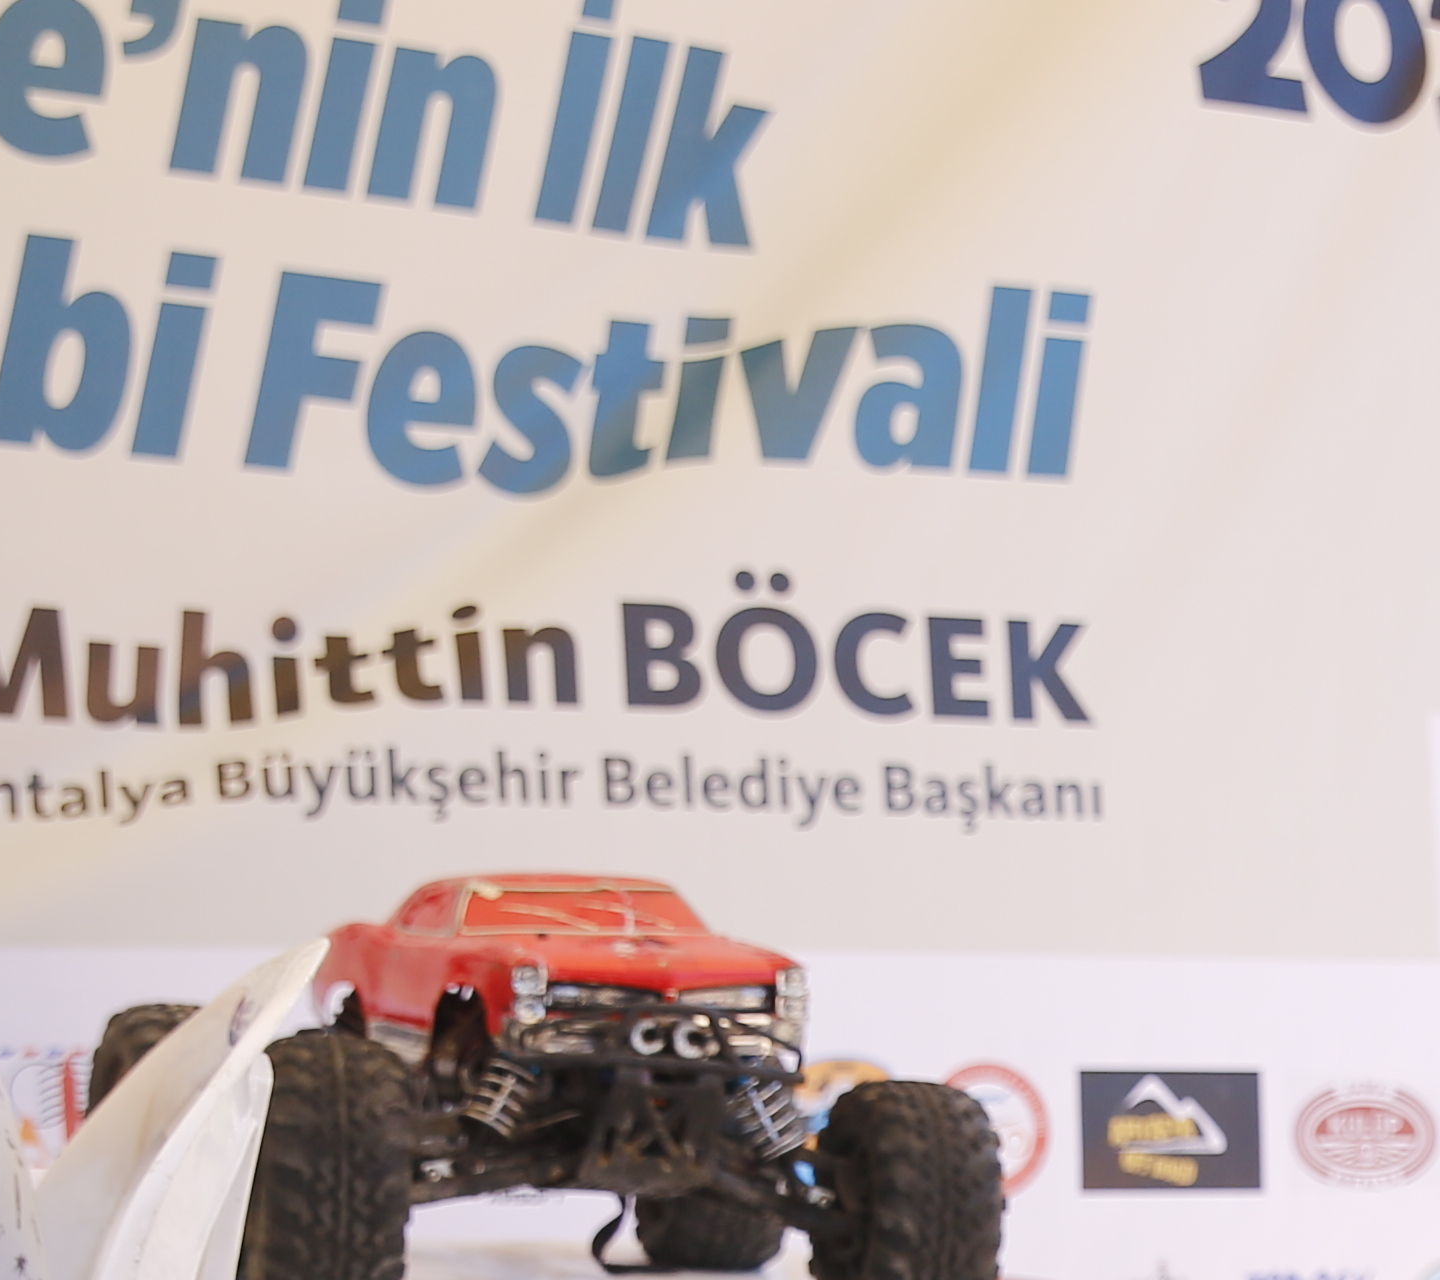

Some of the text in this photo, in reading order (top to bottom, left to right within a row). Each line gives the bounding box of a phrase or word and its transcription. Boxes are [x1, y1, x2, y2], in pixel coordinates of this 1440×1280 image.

[244, 271, 1092, 494] Festivali
[622, 571, 1090, 721] BÖCEK
[215, 748, 579, 822] Büyükşehir
[602, 754, 863, 831] Belediye
[884, 764, 1104, 834] Başkanı
